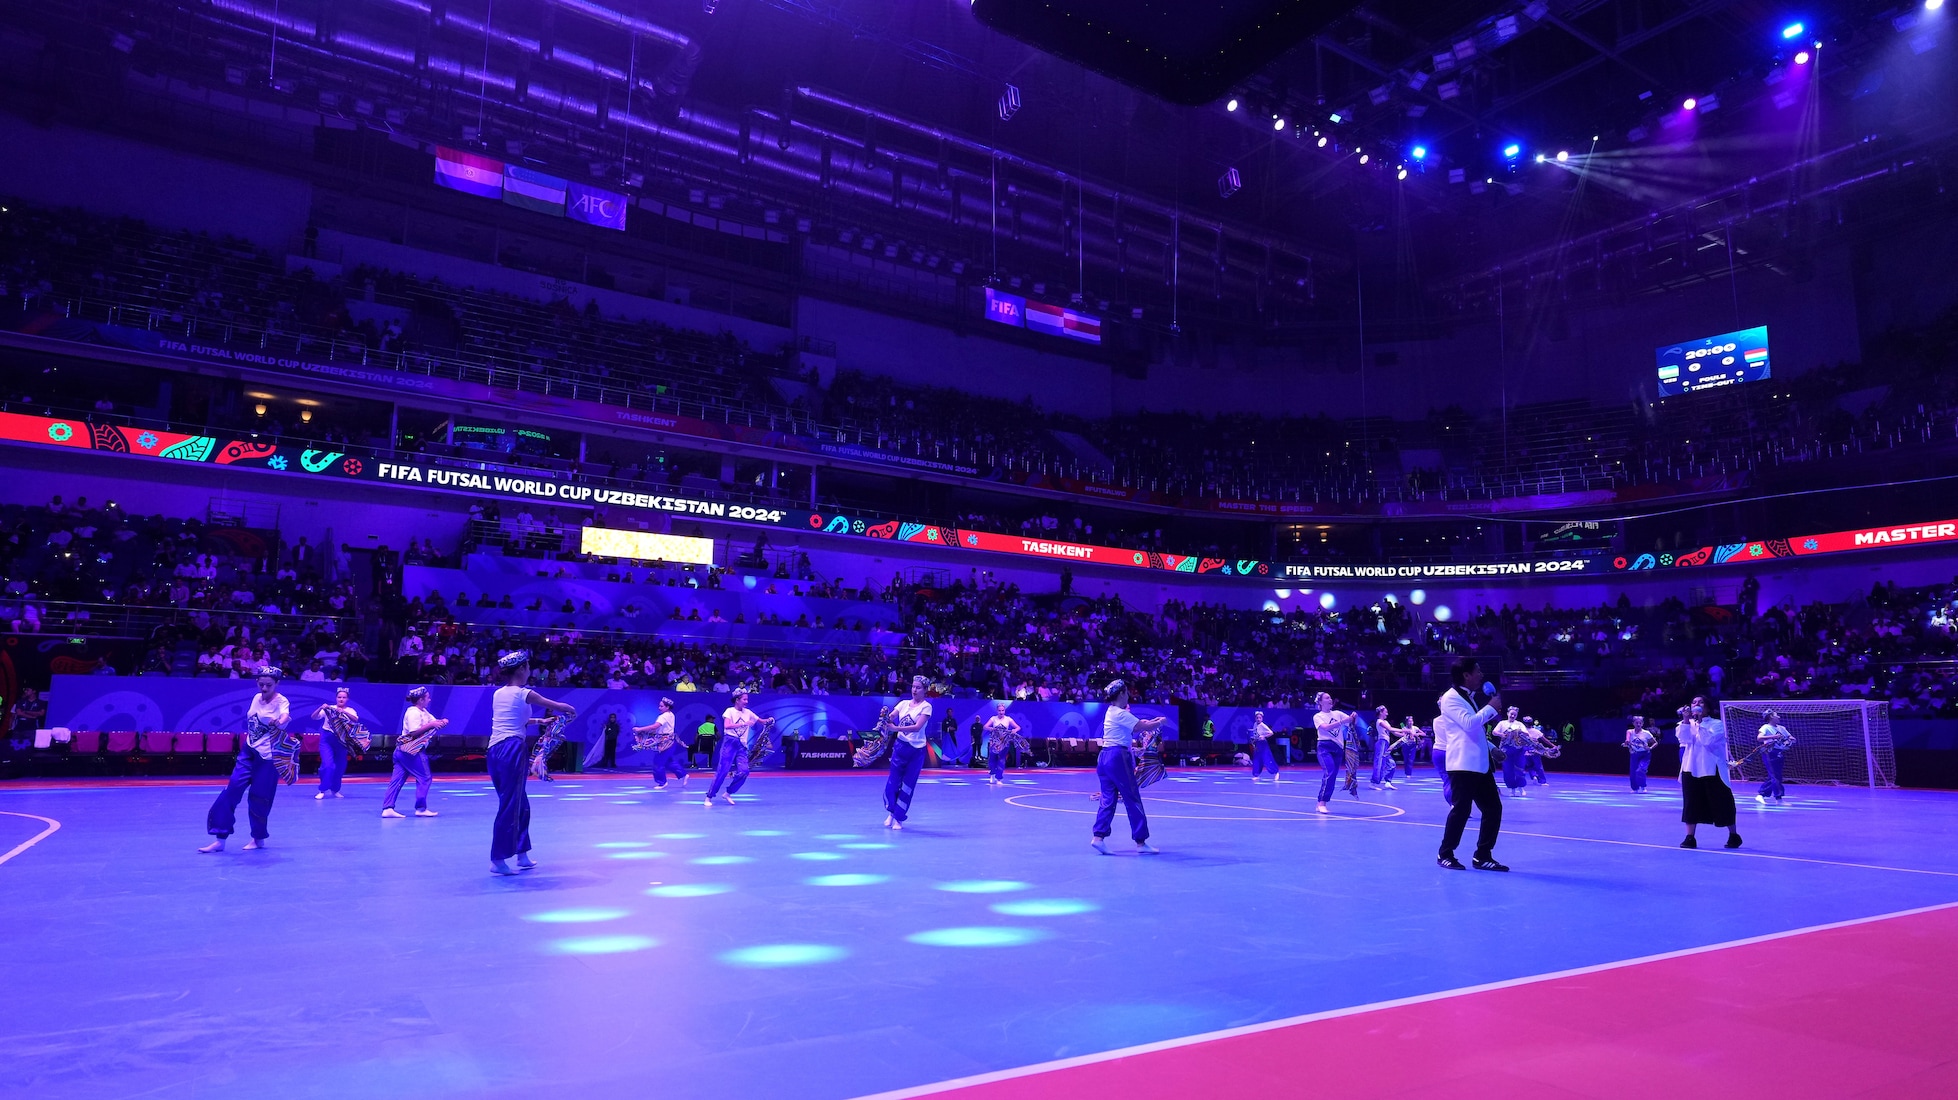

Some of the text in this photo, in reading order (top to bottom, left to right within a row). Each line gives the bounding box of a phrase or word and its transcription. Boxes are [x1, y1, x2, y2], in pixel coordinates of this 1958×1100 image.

[572, 193, 614, 218] AFC
[991, 298, 1020, 317] FIFA
[160, 339, 188, 352] FIFA
[190, 344, 232, 359] FUTSAL
[234, 351, 276, 365] WORLD
[278, 358, 300, 369] CUP
[301, 361, 394, 383] UZBEKISTAN
[1685, 343, 1736, 360] 20:00
[616, 411, 677, 427] TASHKENT
[821, 443, 837, 452] FIFA
[838, 447, 862, 457] FUTSAL
[862, 450, 887, 461] WORLD
[887, 454, 900, 462] CUP
[900, 456, 954, 471] UZBEKISTAN
[378, 463, 422, 482] FIFA
[427, 469, 492, 490] FUTSAL
[493, 476, 556, 497] WORLD
[559, 484, 592, 501] CUP
[593, 488, 725, 517] UZBEKISTAN
[1219, 501, 1314, 513] MASTER THE SPEED
[1854, 523, 1956, 546] MASTER
[1022, 540, 1093, 558] TASHKENT
[1285, 565, 1311, 576] FIFA
[1313, 566, 1354, 577] FUTSAL
[1354, 566, 1397, 577] WORLD
[1398, 566, 1422, 576] CUP
[1423, 562, 1531, 576] UZBEKISTAN
